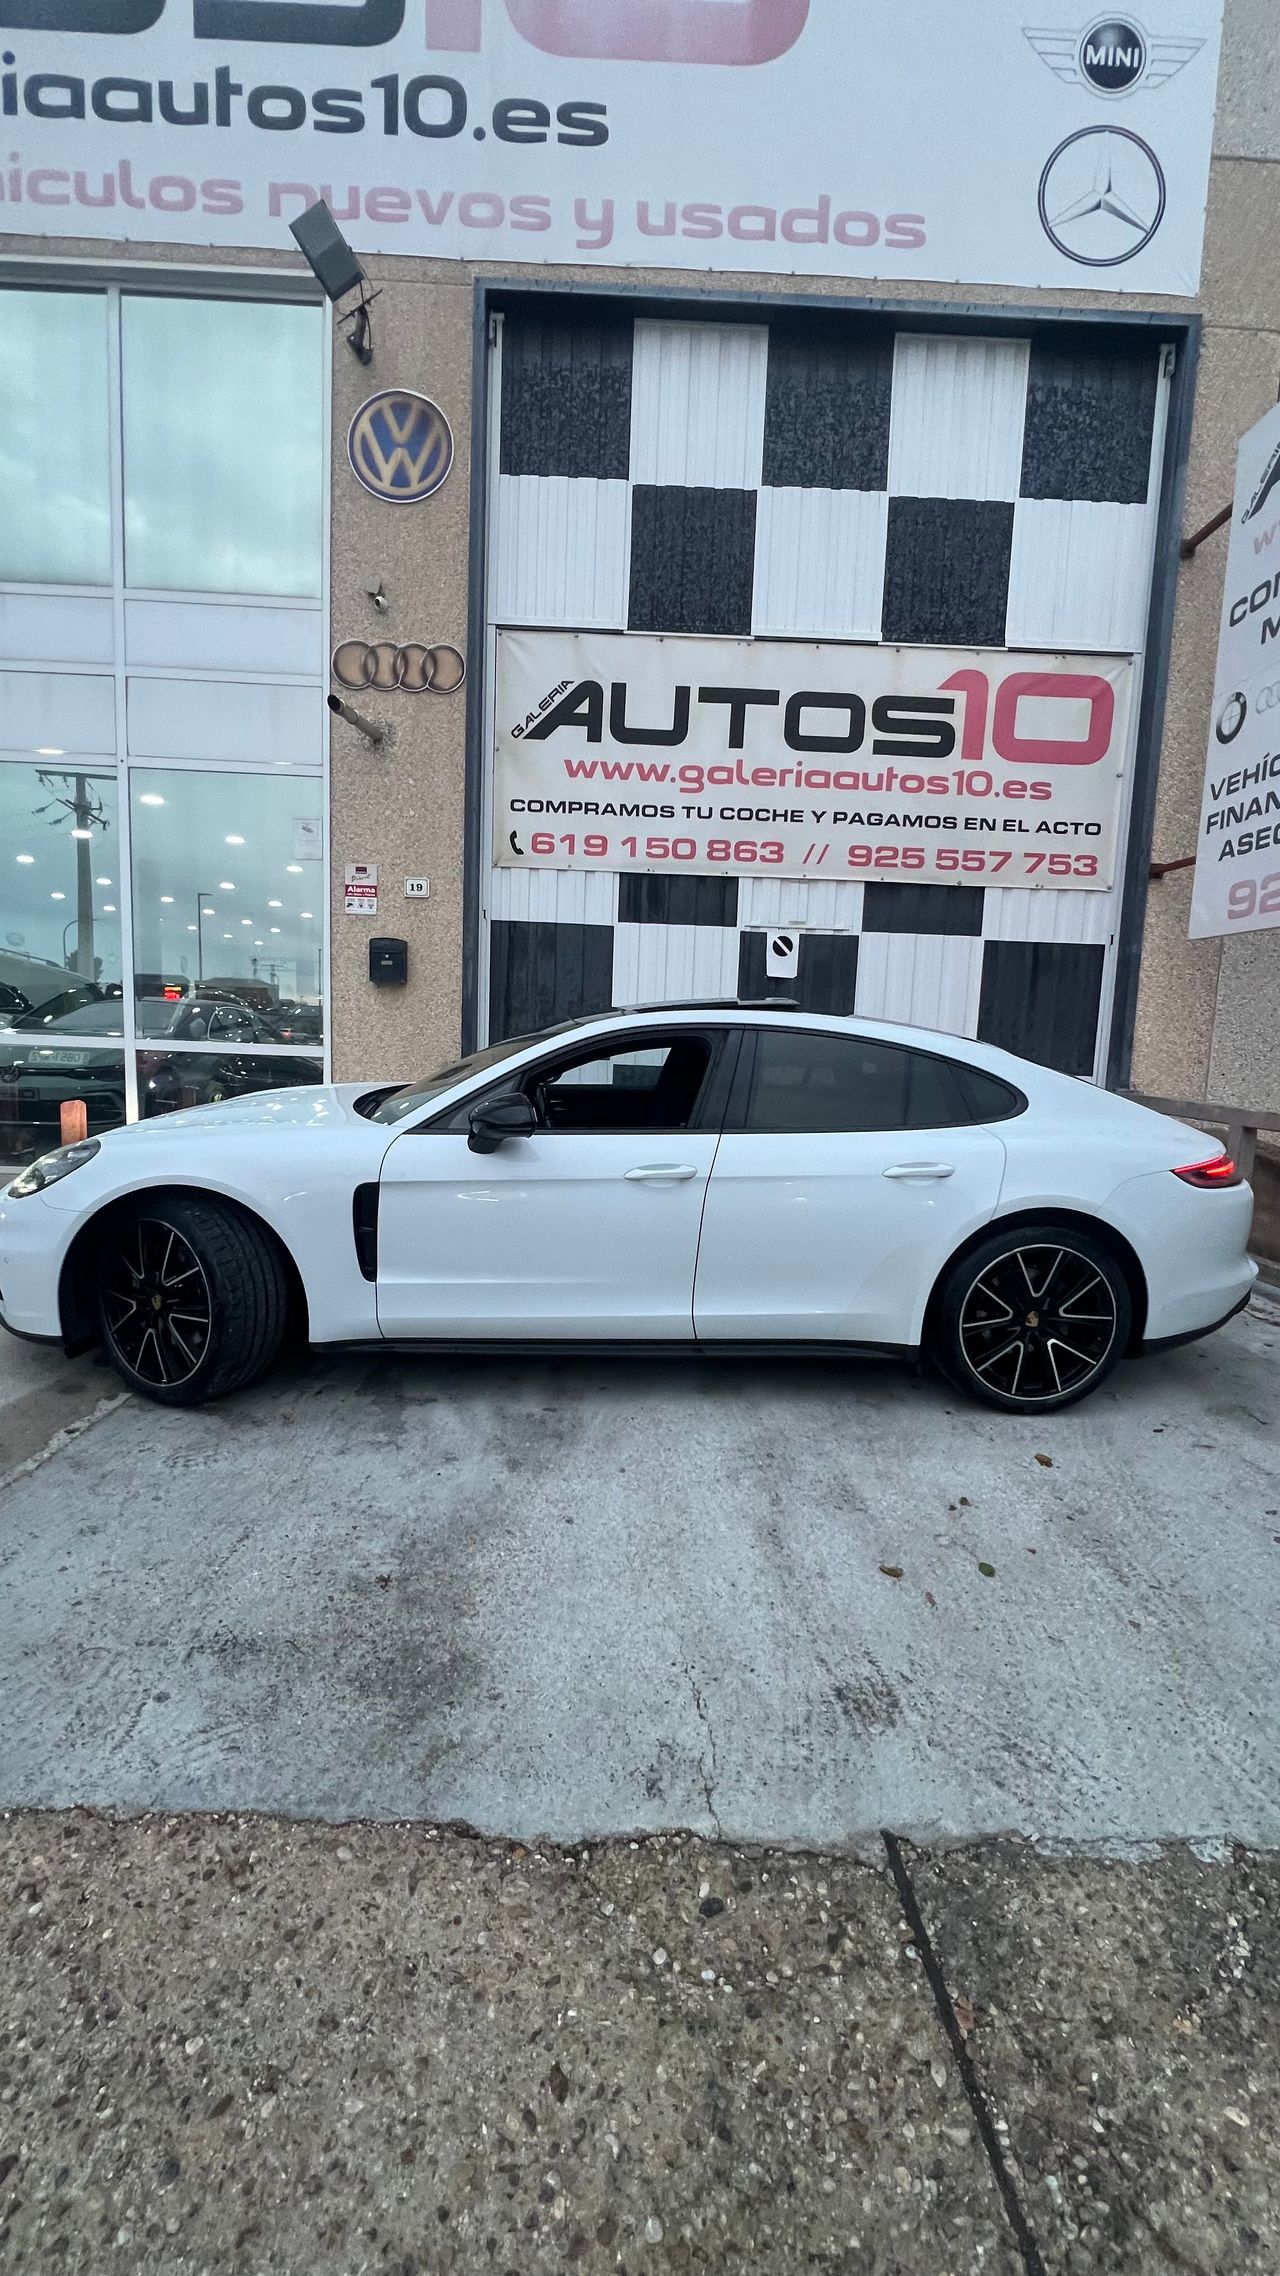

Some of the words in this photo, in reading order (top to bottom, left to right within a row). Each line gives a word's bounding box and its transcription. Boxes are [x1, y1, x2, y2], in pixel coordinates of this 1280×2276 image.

[1086, 44, 1139, 68] MINI
[1, 50, 609, 147] iaautos10.es
[0, 150, 245, 215] iculos
[574, 198, 614, 250] y
[636, 194, 926, 249] usados
[510, 680, 575, 739] GALERIA
[522, 668, 1115, 766] AUTOS10
[563, 758, 1052, 801] www.galeriaautos10.es
[510, 798, 675, 819] COMPRAMOS
[682, 805, 713, 820] TU
[719, 806, 804, 823] COCHE
[811, 810, 827, 824] Y
[833, 810, 958, 830] PAGAMOS
[963, 816, 997, 832] EN
[1002, 818, 1030, 833] EL
[1035, 821, 1102, 836] ACTO
[531, 832, 608, 857] 619
[621, 836, 697, 861] 150
[706, 839, 785, 864] 863
[847, 845, 925, 869] 925
[935, 848, 1013, 873] 557
[1023, 852, 1098, 877] 753
[409, 883, 423, 892] 19
